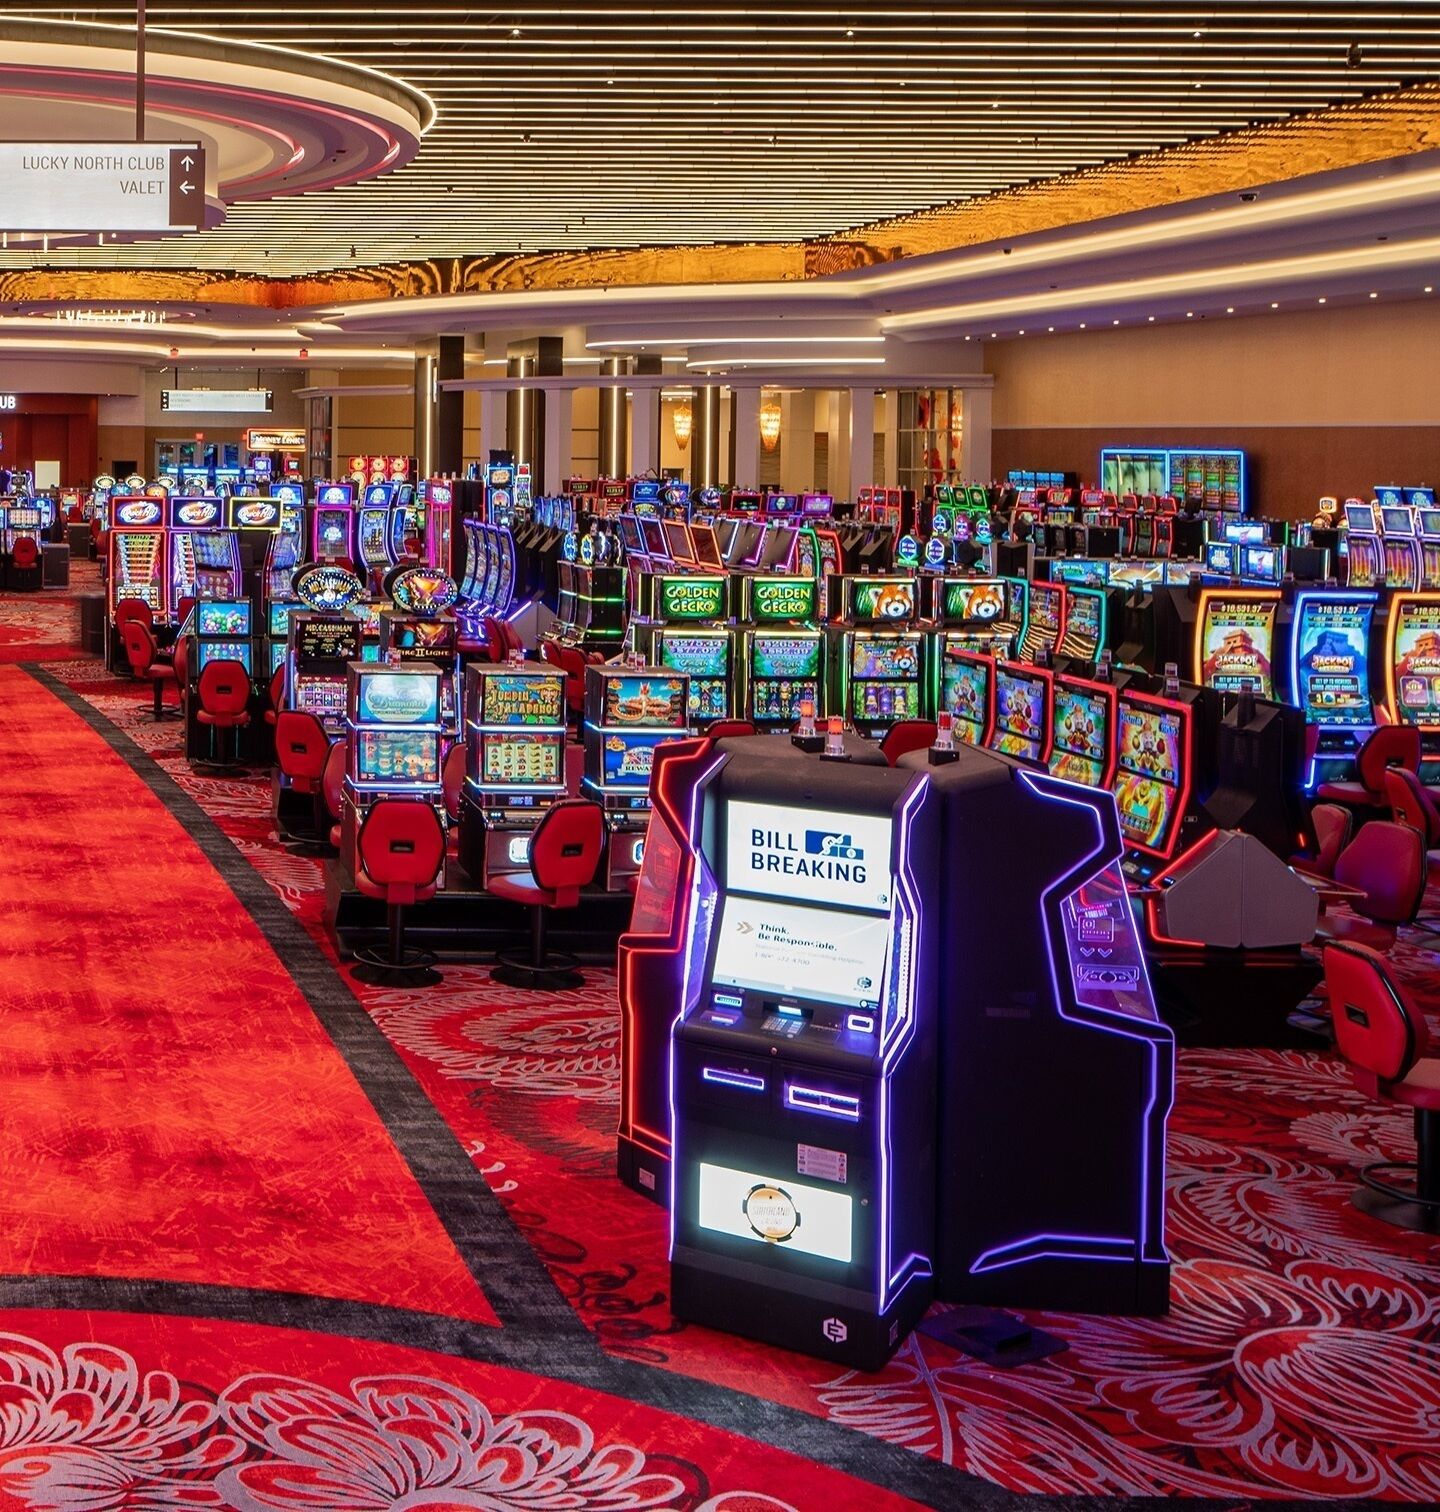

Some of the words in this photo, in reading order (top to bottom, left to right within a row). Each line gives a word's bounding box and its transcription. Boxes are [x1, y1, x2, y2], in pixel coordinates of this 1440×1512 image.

[23, 156, 69, 171] LUCKY
[73, 156, 123, 171] NORTH
[127, 156, 165, 171] CLUB
[120, 180, 165, 194] VALET
[666, 586, 719, 599] GOLDEN
[757, 586, 810, 599] GOLDEN
[669, 599, 716, 613] GECKO
[761, 600, 806, 613] GECKO
[1216, 655, 1258, 668] JACKPOT
[1312, 656, 1354, 669] JACKPOT
[751, 829, 799, 852] BILL
[751, 852, 867, 884] BREAKING
[760, 923, 790, 934] Think.
